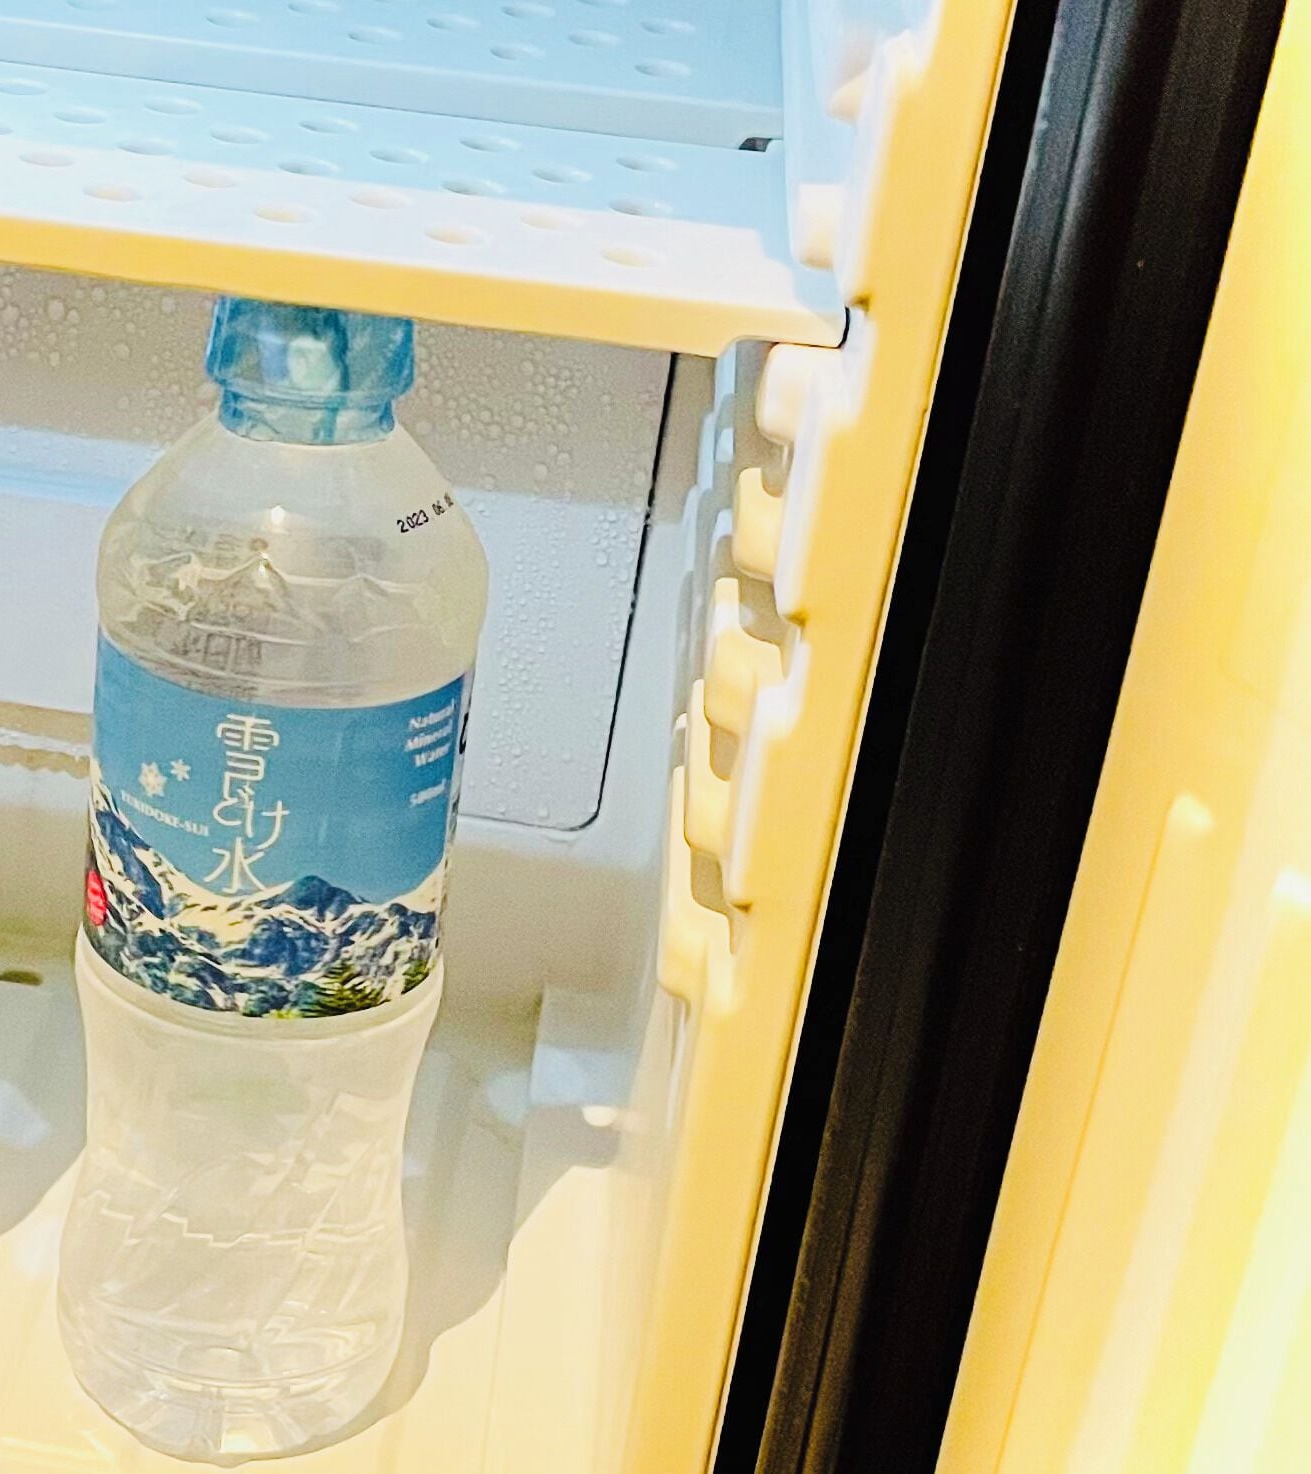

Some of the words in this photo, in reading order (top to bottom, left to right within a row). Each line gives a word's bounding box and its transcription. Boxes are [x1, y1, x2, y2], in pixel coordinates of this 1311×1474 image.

[397, 509, 429, 533] 2023
[409, 697, 455, 731] Natural
[404, 718, 452, 752] Mineral
[415, 742, 451, 767] Water
[204, 713, 290, 893] 雪どけ水
